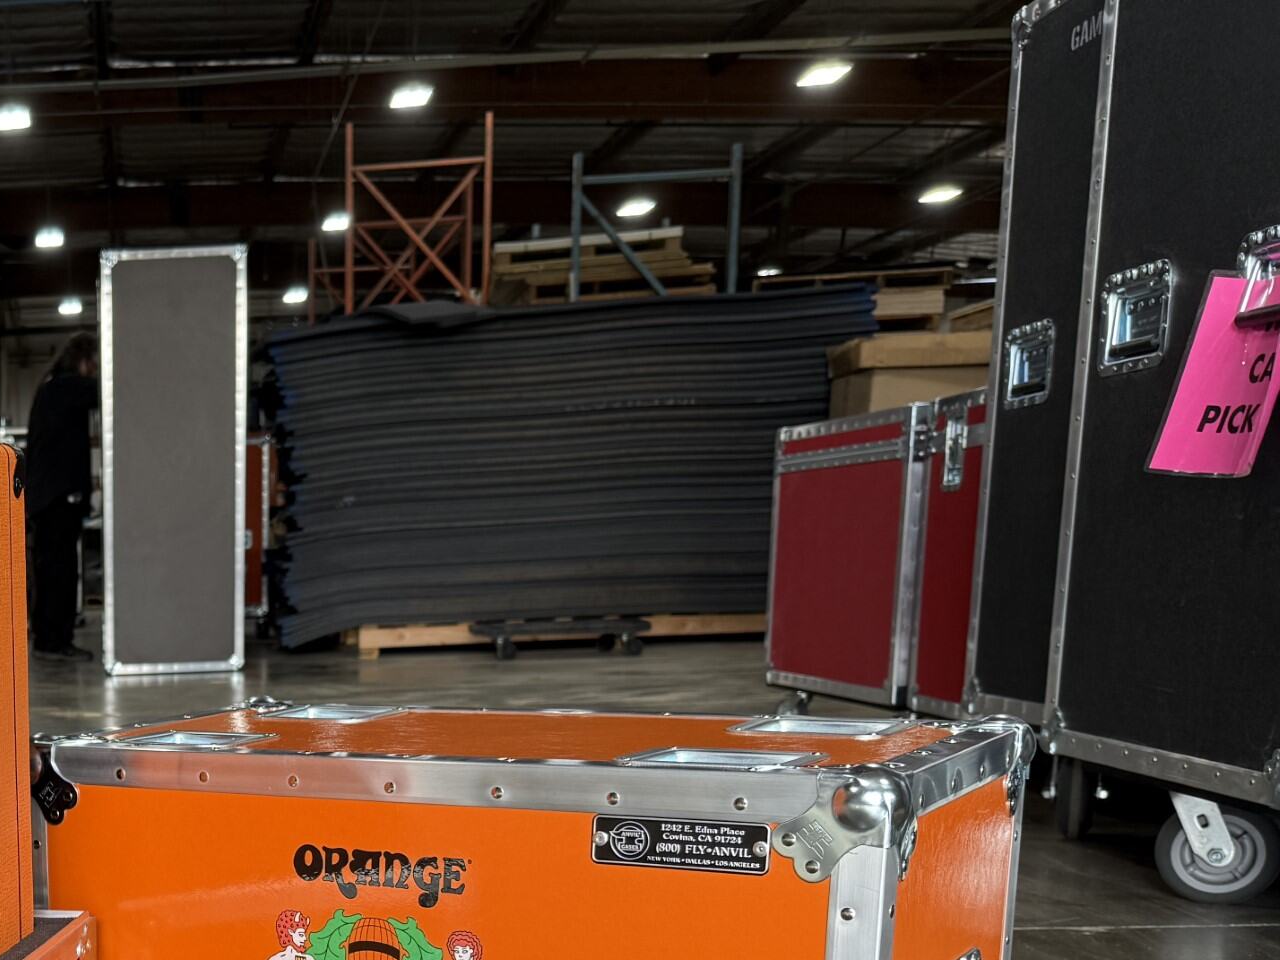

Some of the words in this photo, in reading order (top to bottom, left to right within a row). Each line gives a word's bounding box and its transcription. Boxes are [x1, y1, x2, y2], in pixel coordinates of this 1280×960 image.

[1196, 403, 1261, 434] PICK
[661, 823, 682, 833] 1242
[684, 825, 693, 833] E.
[695, 825, 718, 835] Edna
[720, 826, 745, 836] Place
[698, 834, 712, 843] CA
[714, 835, 742, 845] 91724
[656, 842, 681, 854] (800)
[293, 844, 467, 908] ORANGE
